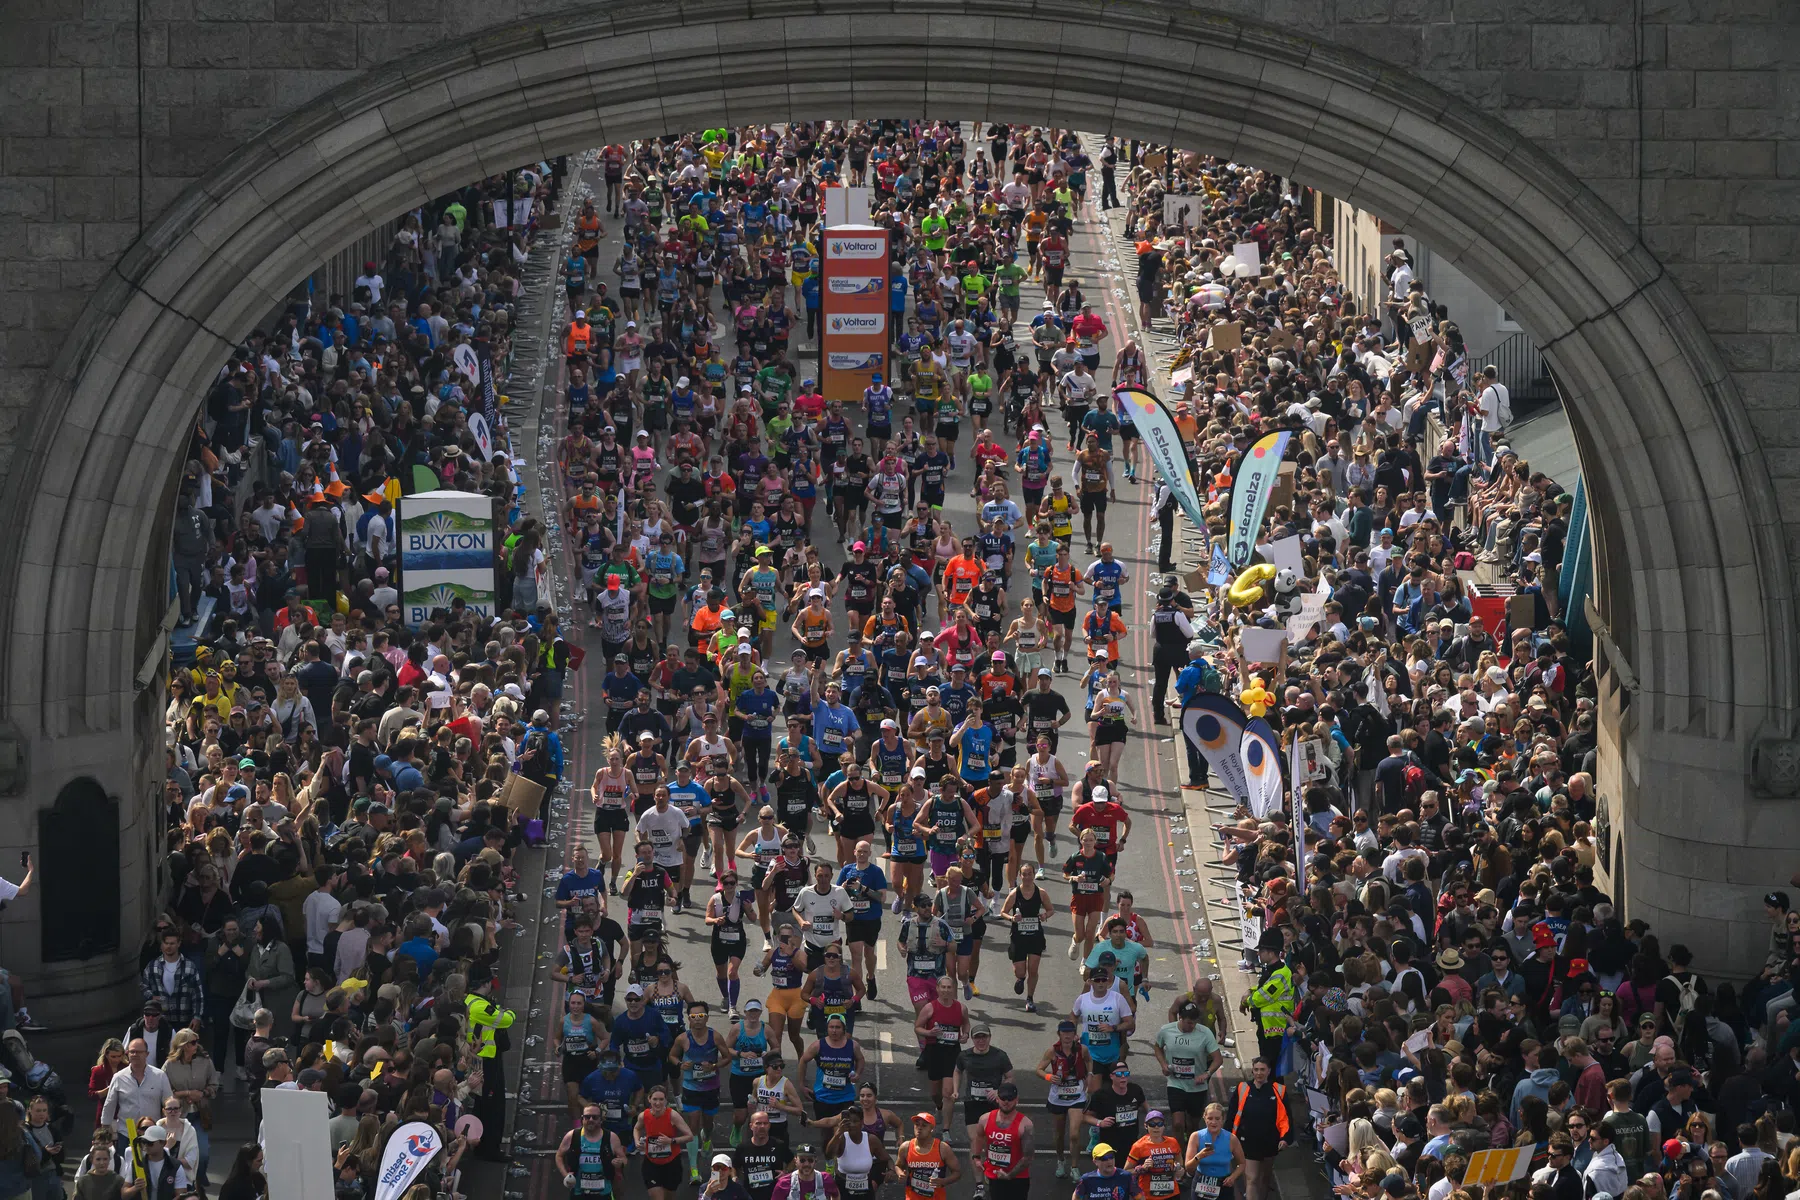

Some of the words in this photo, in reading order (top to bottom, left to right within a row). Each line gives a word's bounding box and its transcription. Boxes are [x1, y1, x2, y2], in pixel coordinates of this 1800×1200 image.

[844, 242, 877, 250] Voltarol
[843, 318, 877, 326] Voltarol
[484, 382, 494, 422] RUNNERS
[1238, 472, 1262, 536] demelza
[409, 533, 486, 550] BUXTON
[1228, 752, 1246, 778] Royal
[1219, 758, 1242, 797] Neuro-dis
[642, 880, 658, 888] ALEX
[1548, 922, 1566, 932] ALMER
[1174, 1036, 1191, 1046] TOM
[1616, 1126, 1644, 1135] BODEGAS
[989, 1131, 1012, 1141] JOE
[752, 1172, 769, 1181] 43119
[1201, 1175, 1218, 1186] LEAH
